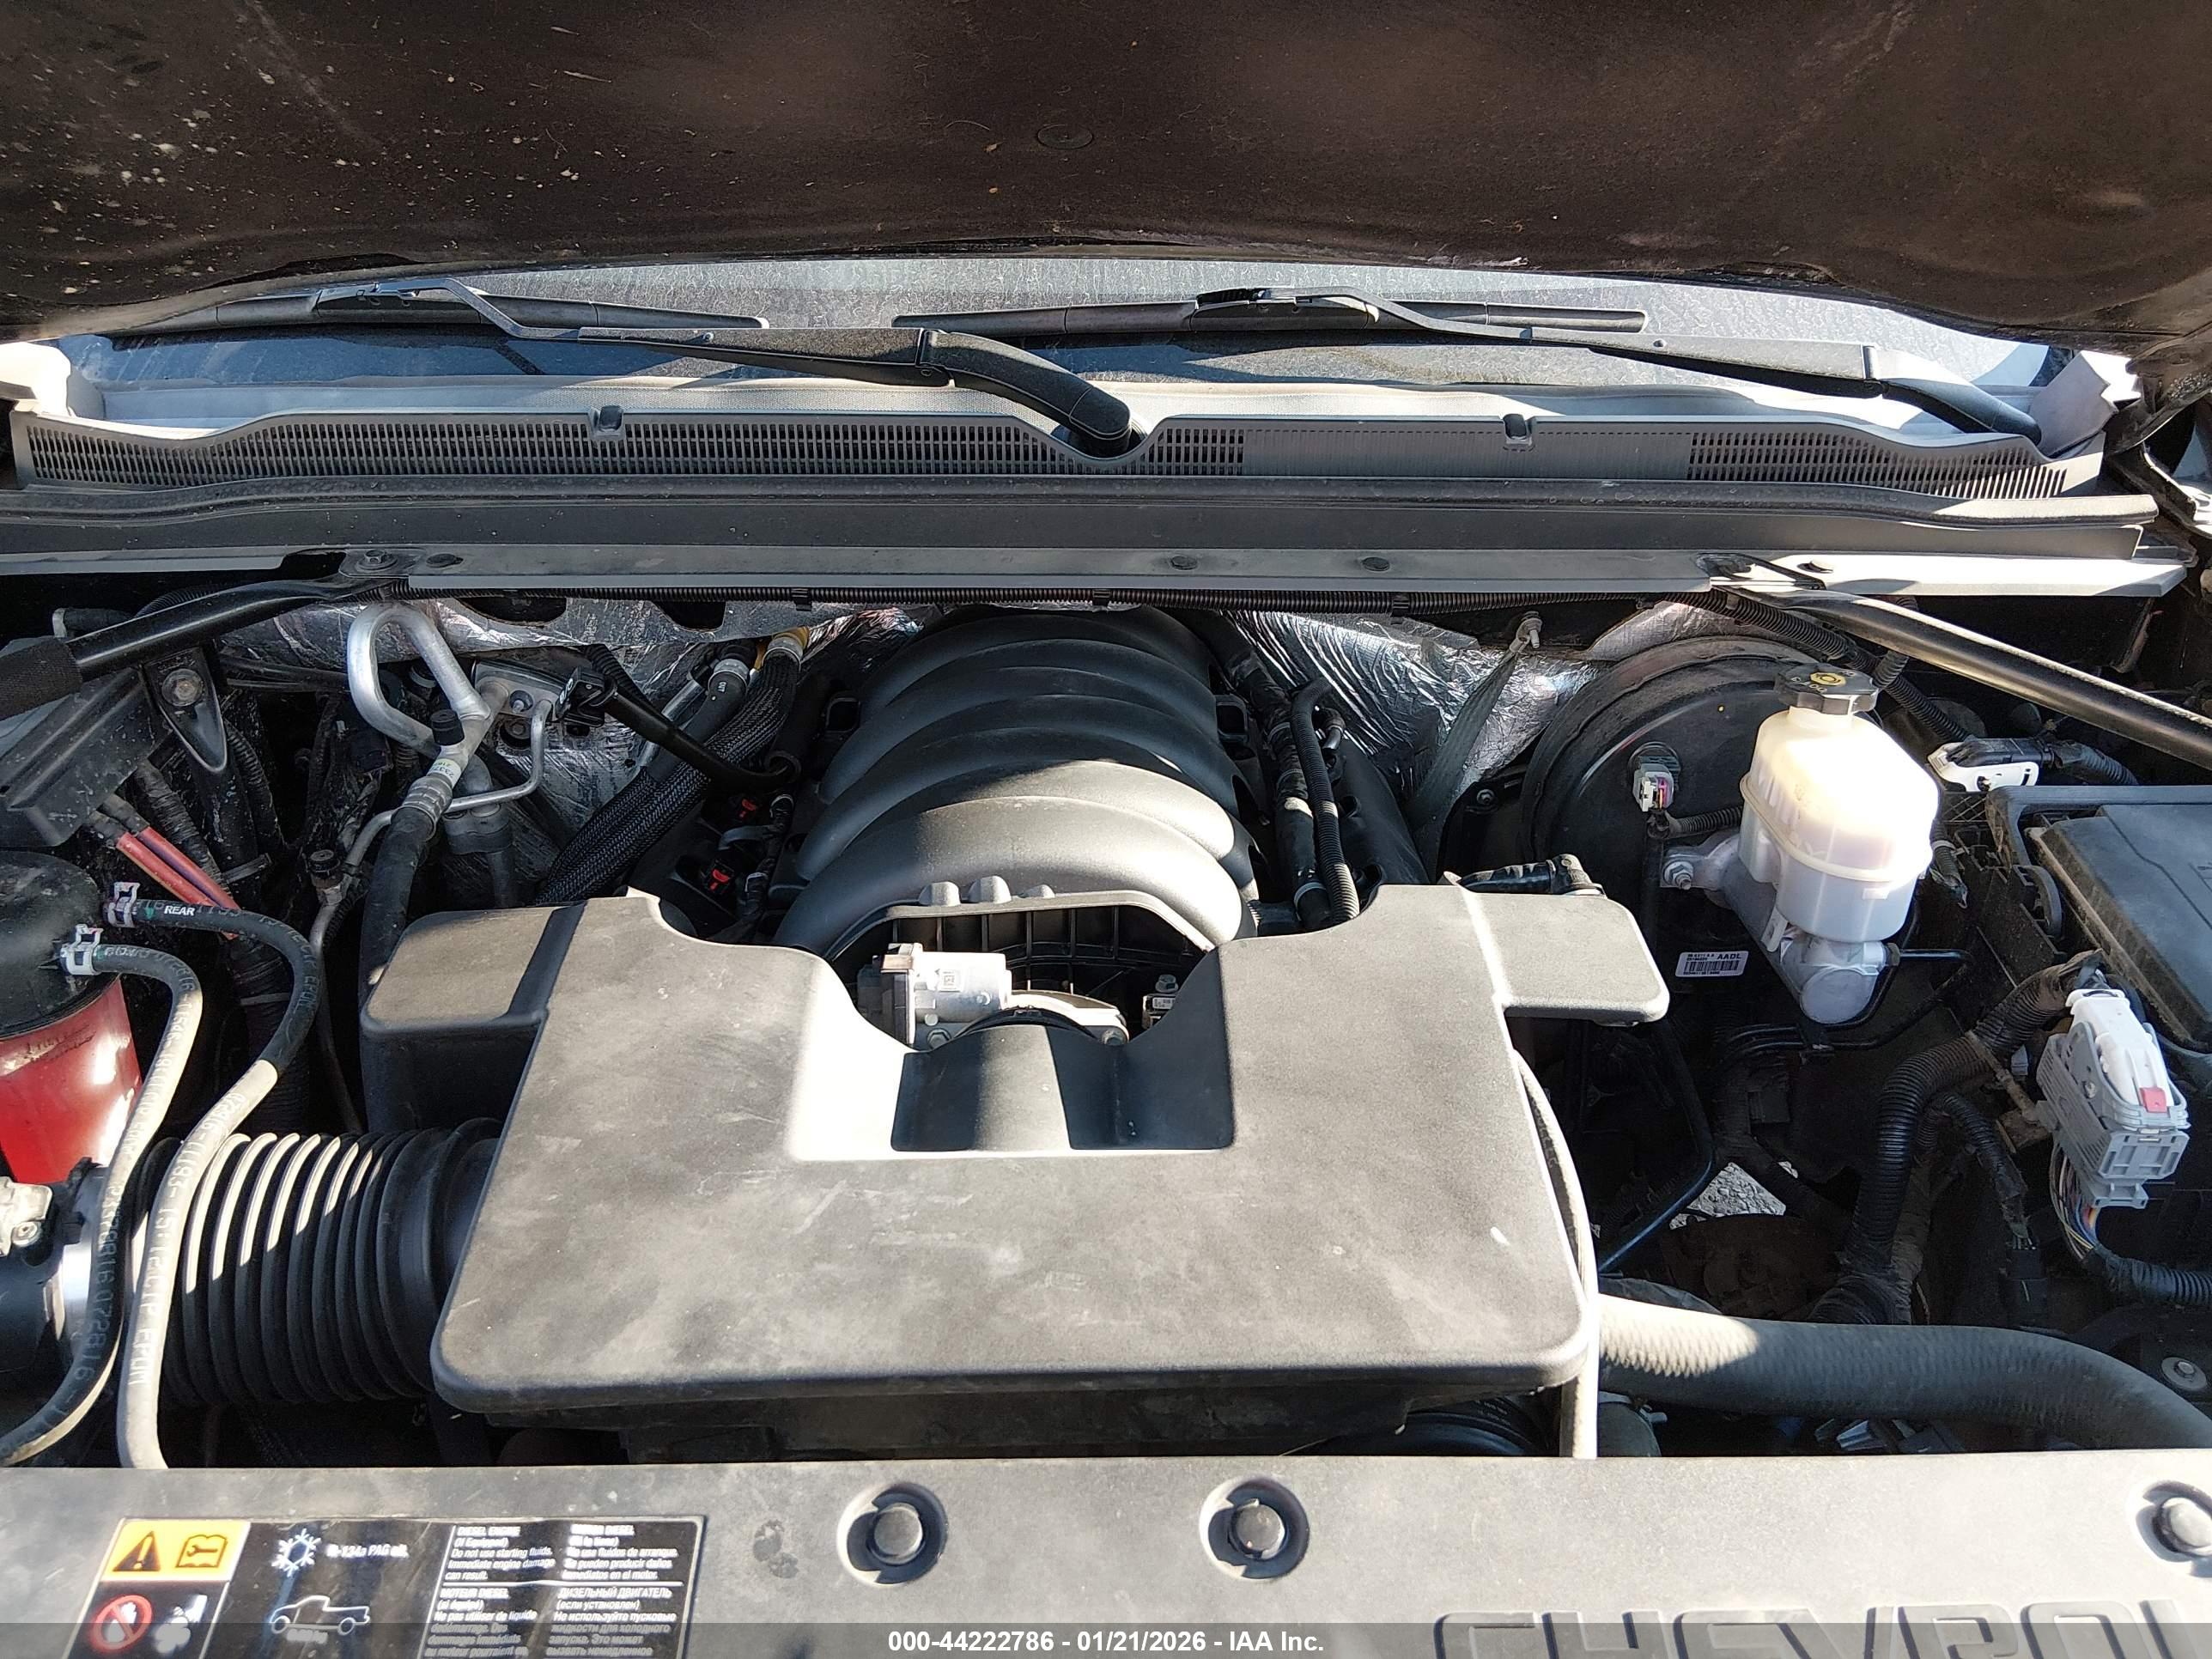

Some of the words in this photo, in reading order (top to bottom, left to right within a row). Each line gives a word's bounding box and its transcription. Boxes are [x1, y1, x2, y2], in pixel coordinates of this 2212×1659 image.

[164, 905, 196, 916] REAR
[465, 1549, 478, 1559] not
[480, 1549, 495, 1558] use
[496, 1548, 528, 1559] starting
[522, 1559, 556, 1569] damage
[617, 1588, 672, 1599] ДВИГАТЕЛЬ
